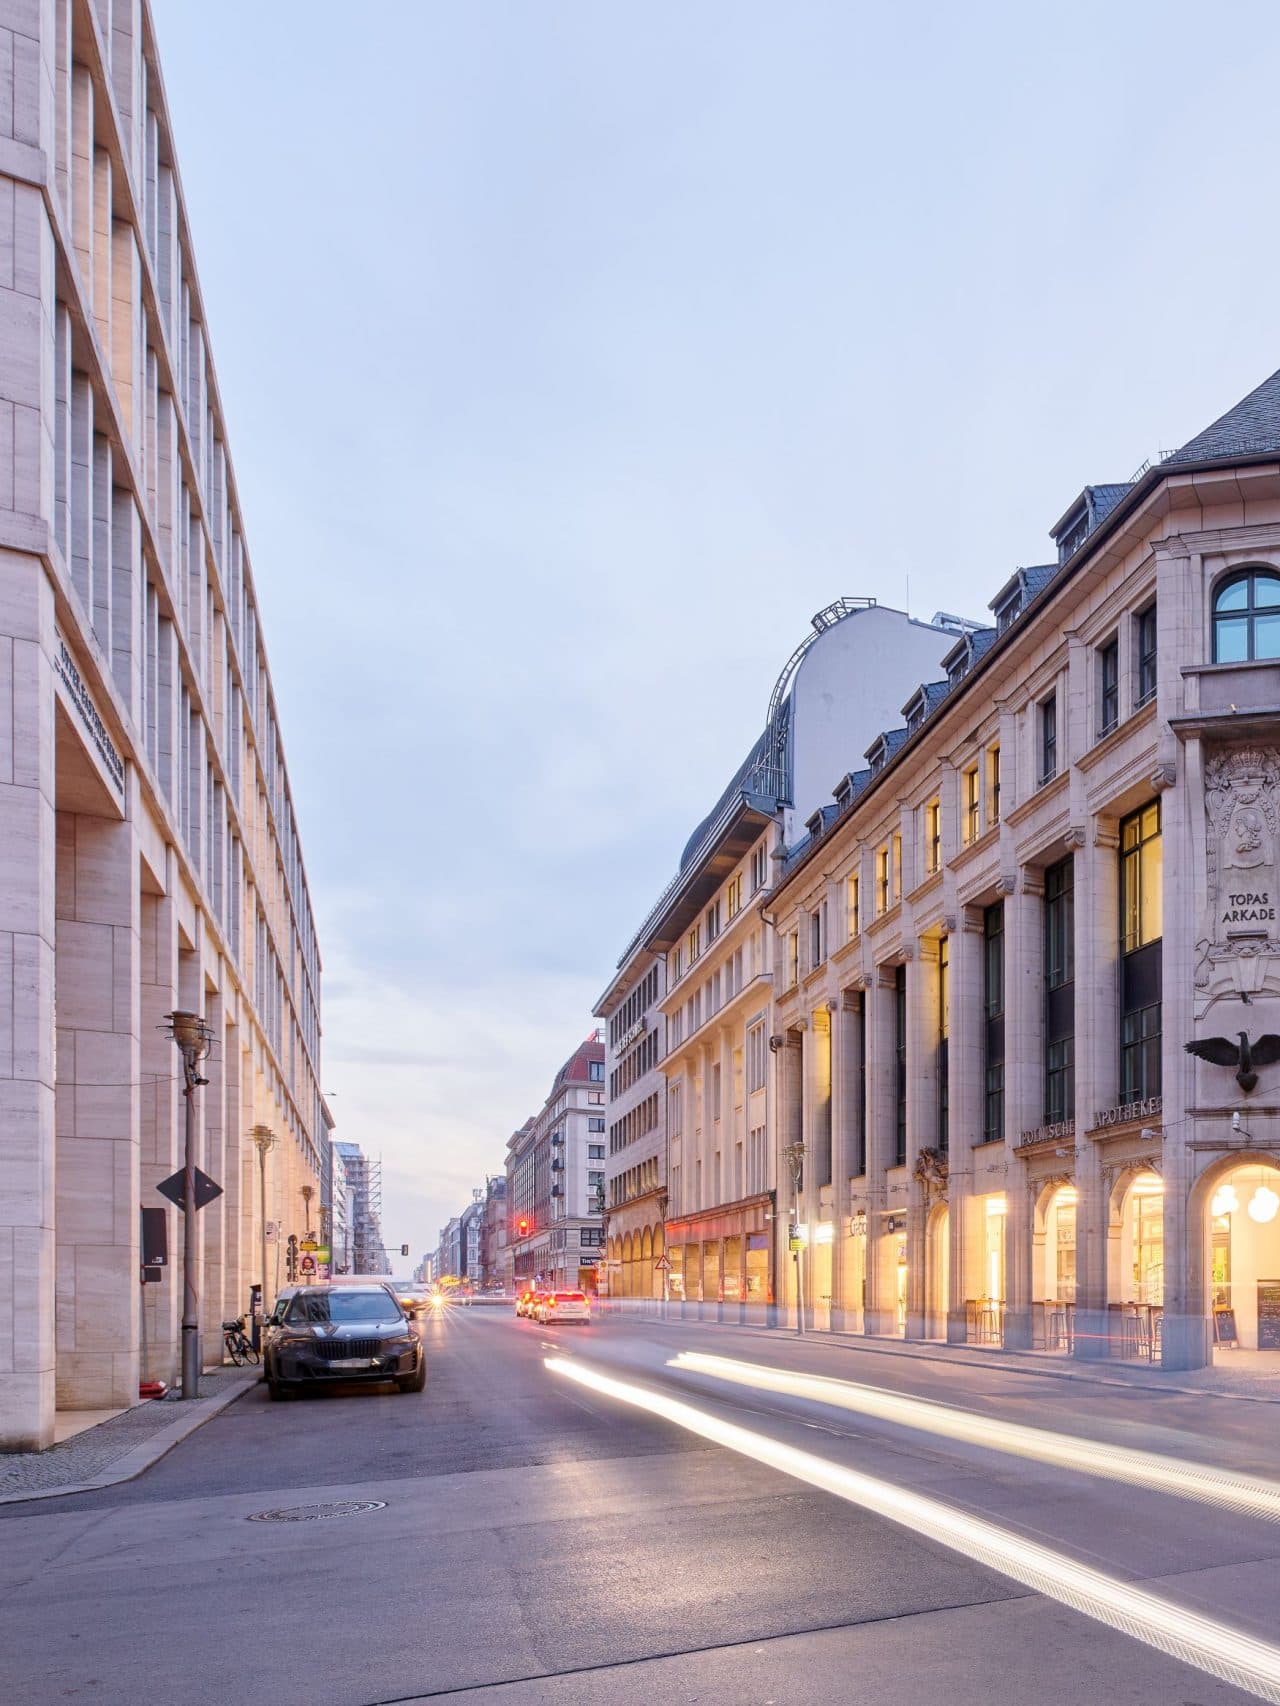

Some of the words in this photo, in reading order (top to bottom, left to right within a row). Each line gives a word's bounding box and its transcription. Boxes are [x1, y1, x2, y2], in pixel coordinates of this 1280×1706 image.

[1228, 893, 1268, 906] TOPAS
[1222, 908, 1276, 923] ARKADE
[1022, 1119, 1075, 1145] POLNISCHE
[1095, 1097, 1156, 1126] APOTHEKE
